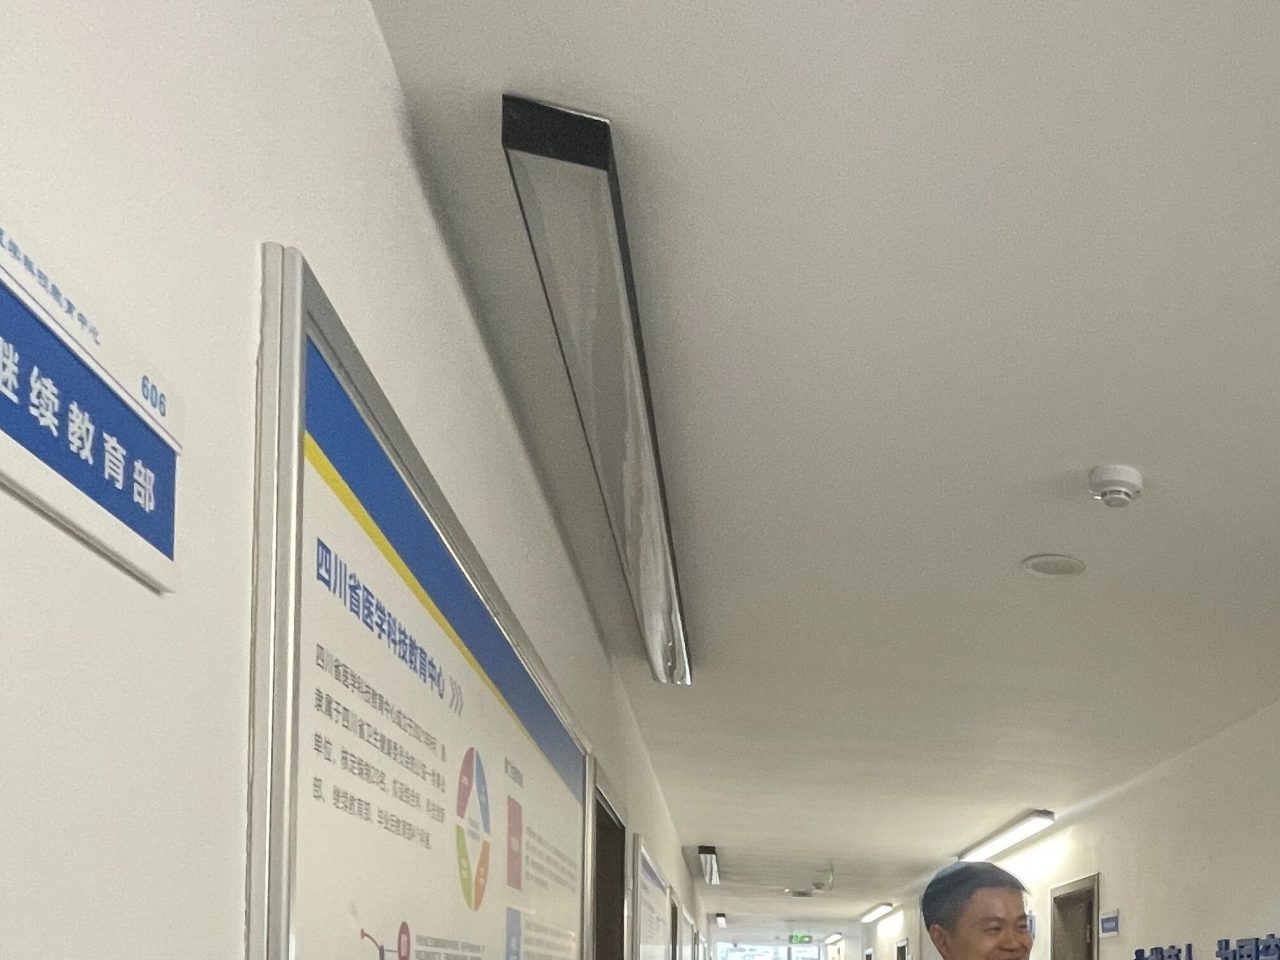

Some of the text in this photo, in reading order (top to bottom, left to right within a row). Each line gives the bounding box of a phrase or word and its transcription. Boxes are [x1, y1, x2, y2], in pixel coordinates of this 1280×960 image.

[141, 374, 167, 417] 606
[316, 538, 445, 700] 四川省医学科技教育中心
